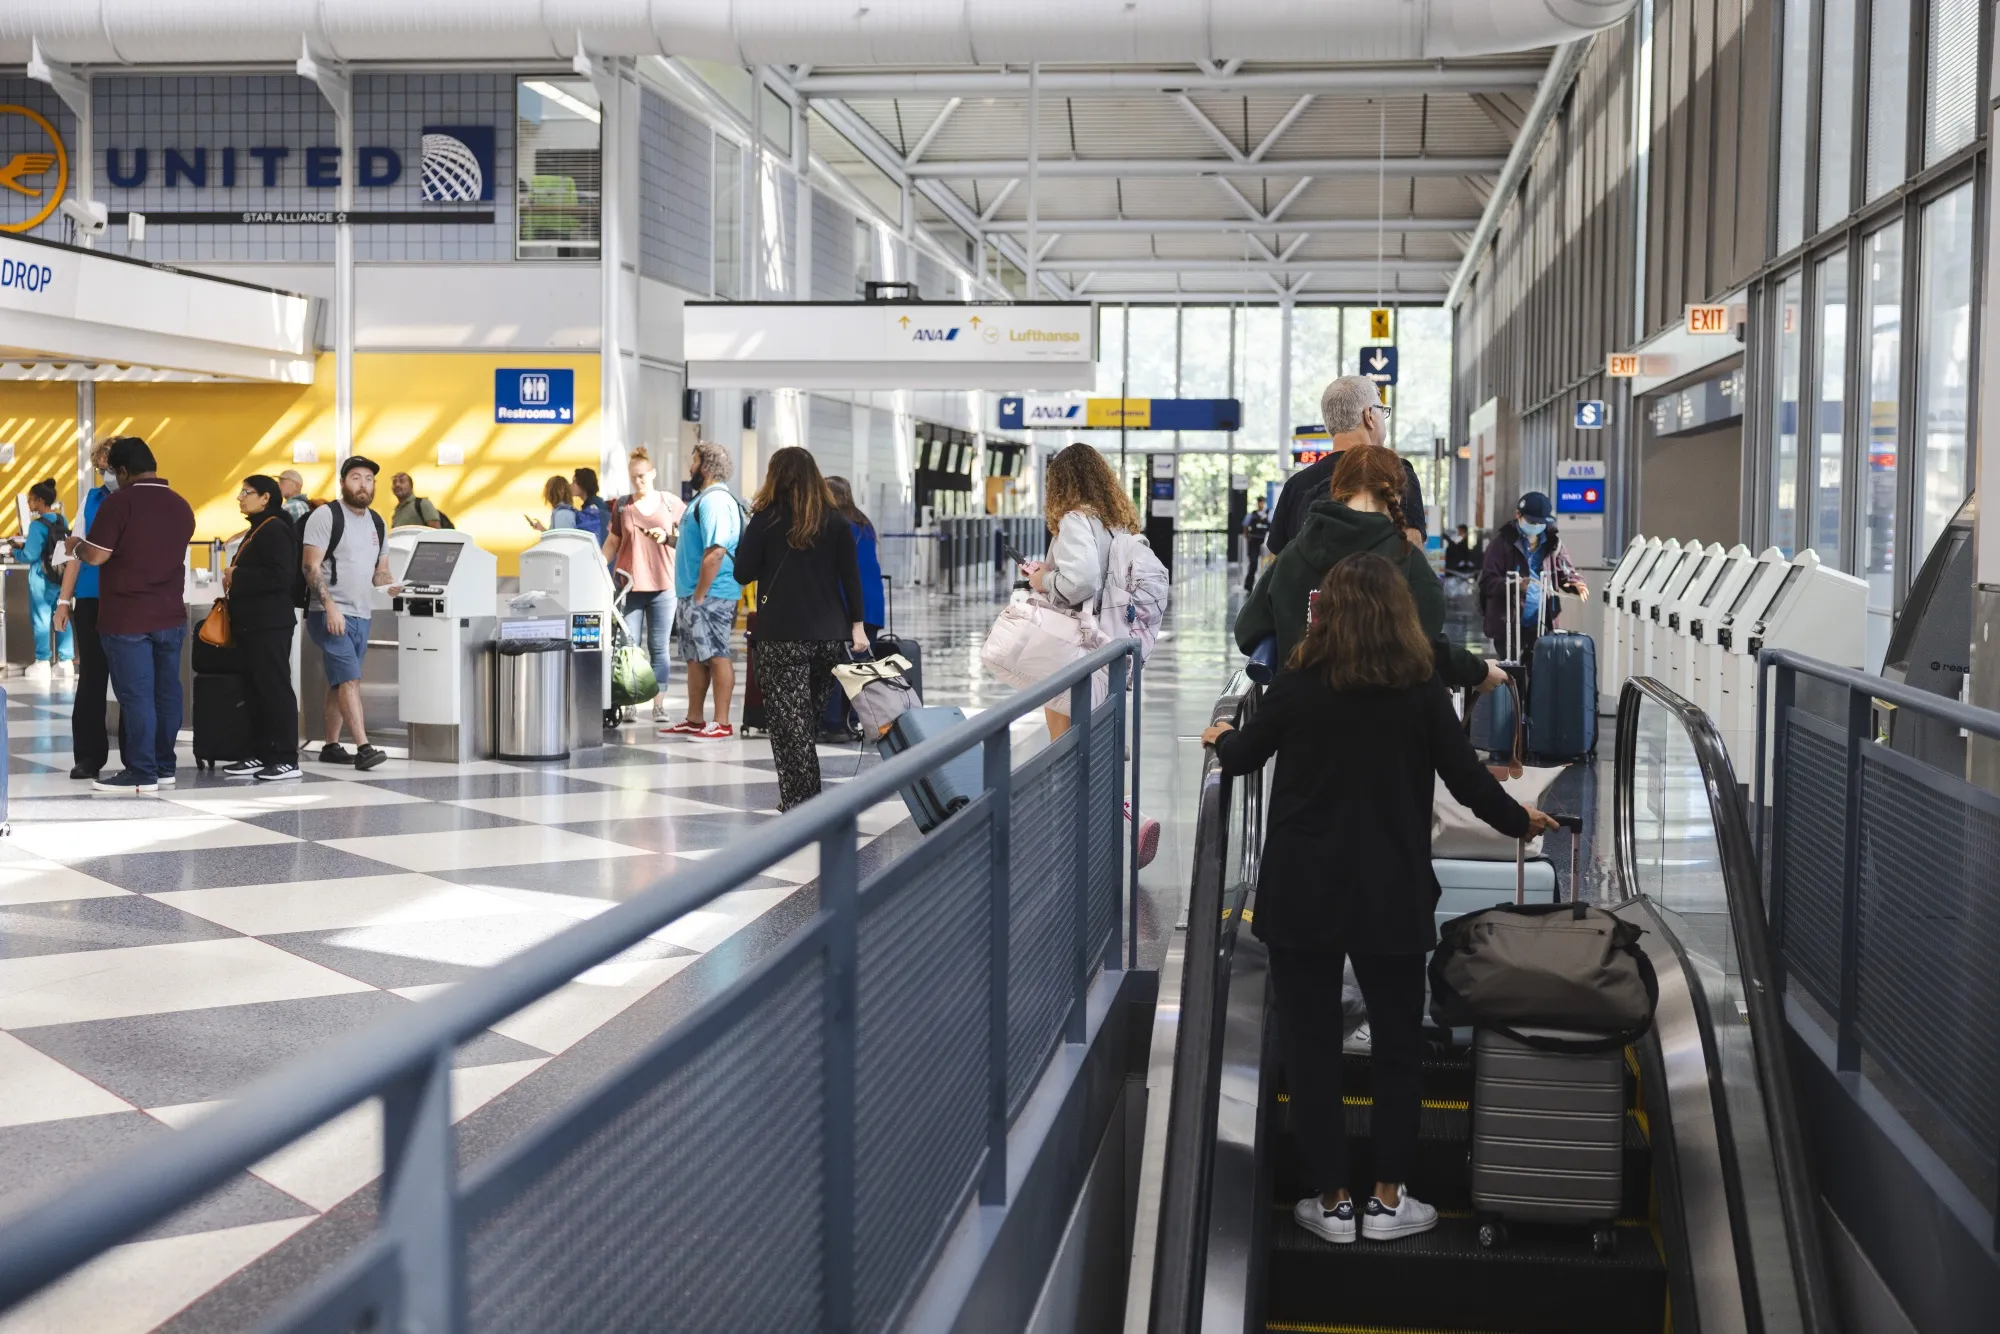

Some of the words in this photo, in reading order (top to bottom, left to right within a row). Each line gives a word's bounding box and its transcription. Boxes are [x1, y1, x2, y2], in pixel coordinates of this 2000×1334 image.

[106, 146, 402, 188] UNITED
[242, 212, 272, 223] STAR
[275, 212, 333, 223] ALLIANCE
[1, 258, 52, 293] DROP
[1691, 308, 1724, 331] EXIT
[912, 328, 944, 341] ANA
[1009, 329, 1080, 342] Lufthansa
[1611, 356, 1637, 374] EXIT
[498, 407, 557, 420] Restrooms
[1030, 406, 1064, 419] ANA
[1567, 466, 1596, 477] ATM
